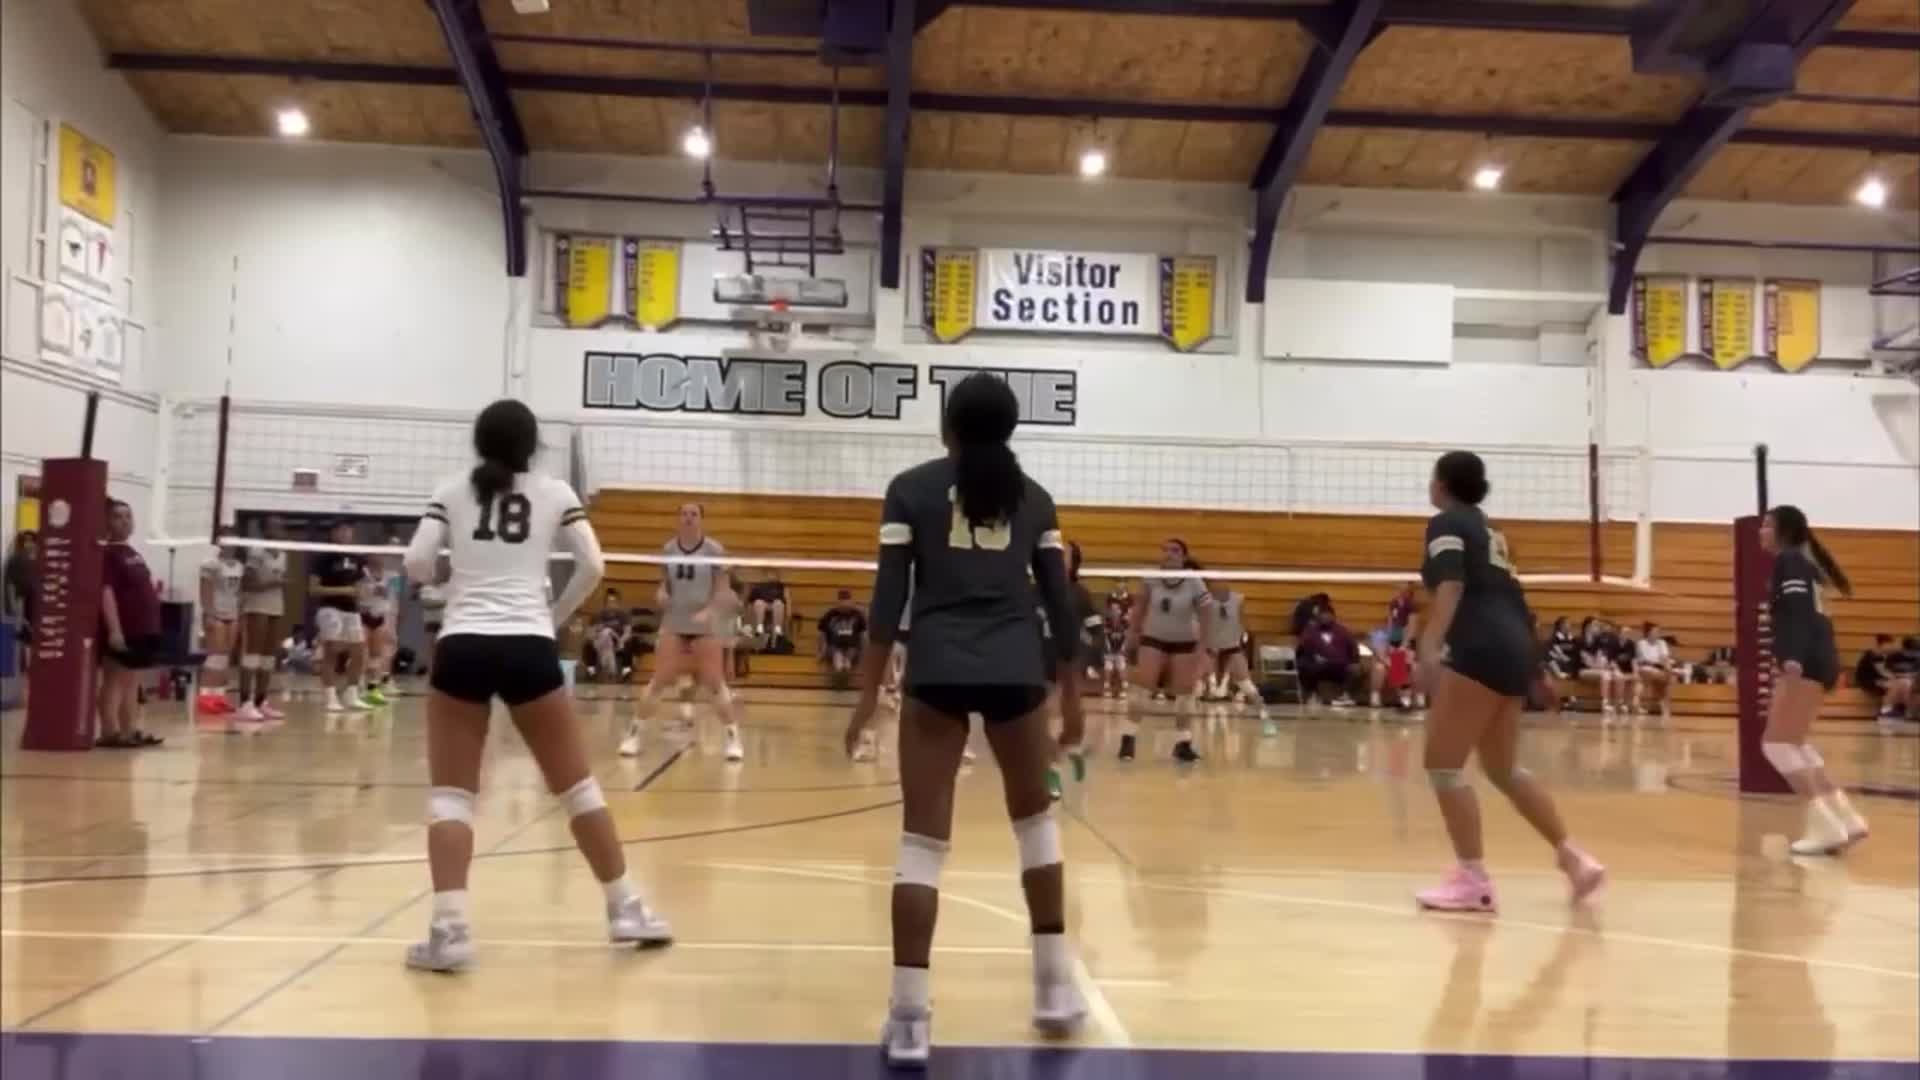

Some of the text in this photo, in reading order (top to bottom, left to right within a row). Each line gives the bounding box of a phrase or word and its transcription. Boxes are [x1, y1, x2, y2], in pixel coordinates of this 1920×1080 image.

[1013, 253, 1121, 289] Visitor
[992, 288, 1139, 325] Section
[584, 351, 806, 416] HOME
[818, 361, 918, 419] OF
[472, 492, 531, 544] 18
